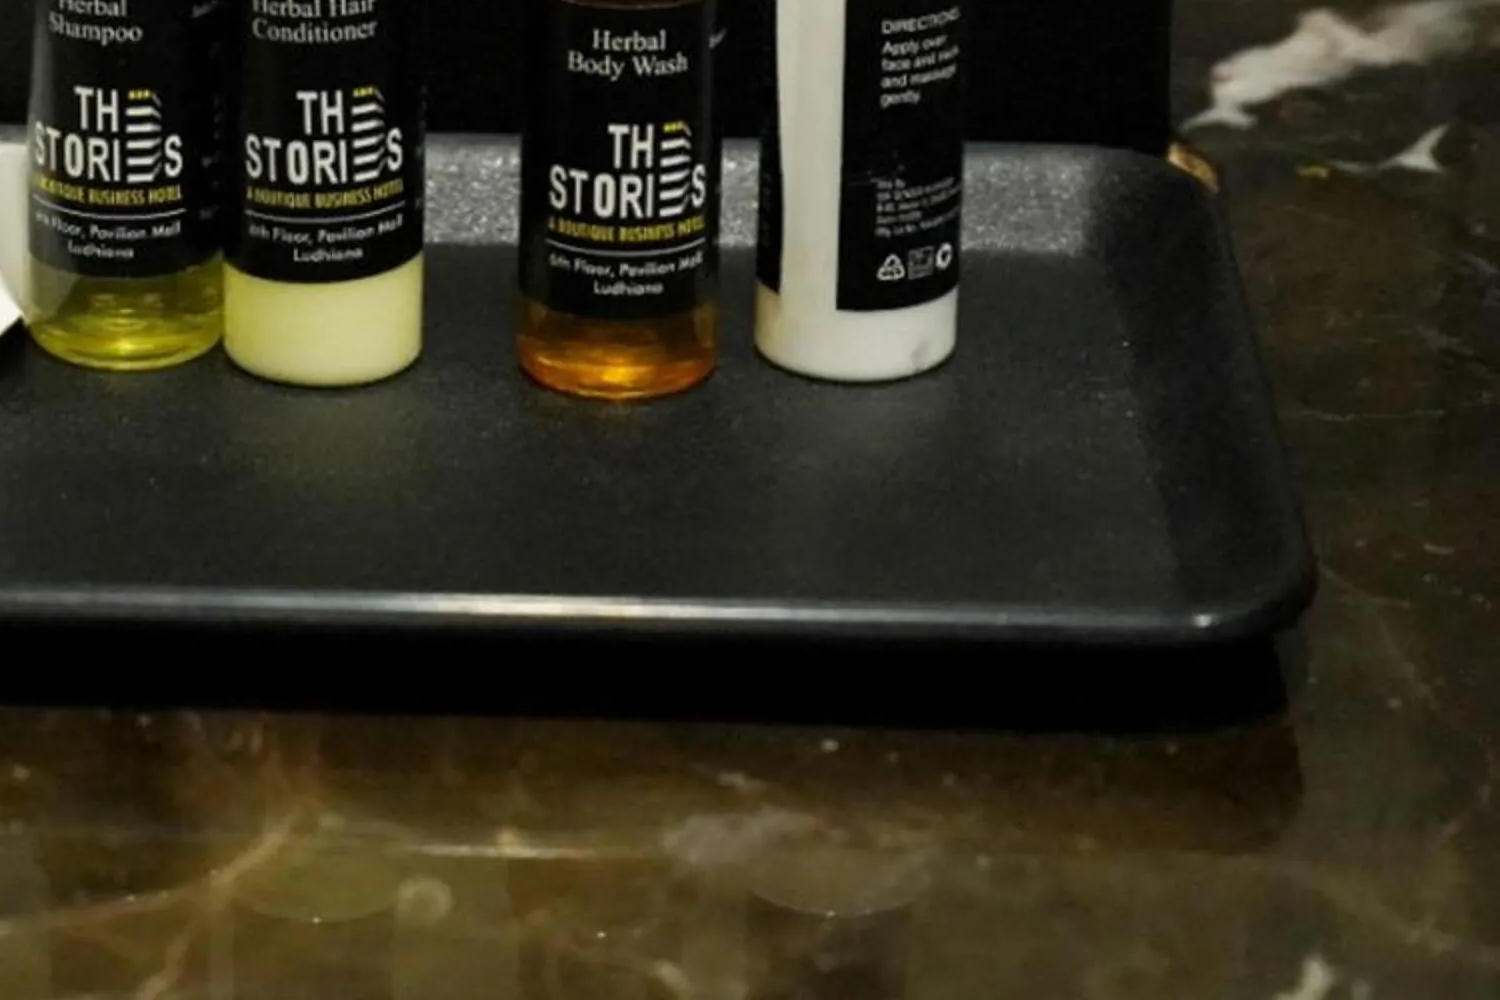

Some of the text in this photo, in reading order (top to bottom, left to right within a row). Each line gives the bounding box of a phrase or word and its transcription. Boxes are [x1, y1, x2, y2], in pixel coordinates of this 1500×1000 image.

[48, 12, 143, 46] Shampoo
[251, 18, 378, 45] Conditioner
[592, 29, 667, 51] Herbal
[568, 50, 689, 81] Body Wash
[245, 127, 403, 185] STORIES
[88, 188, 145, 205] BUSINESS
[549, 164, 706, 219] STORIES
[317, 226, 375, 244] Pavilion
[293, 248, 364, 263] Ludhiana
[619, 261, 677, 278] Pavilion
